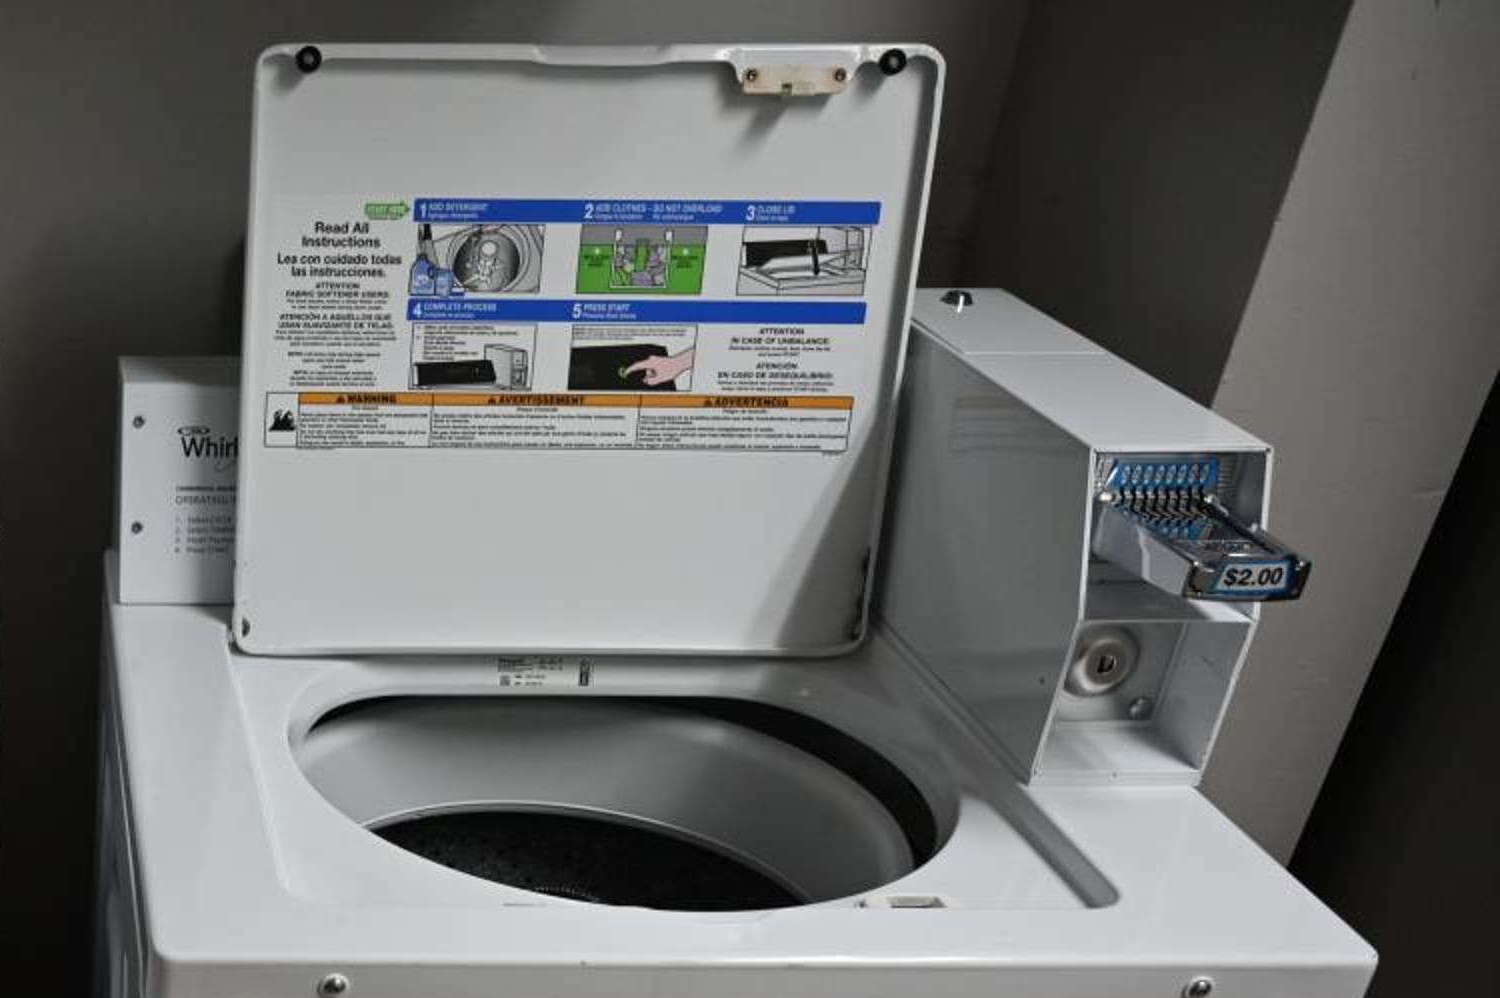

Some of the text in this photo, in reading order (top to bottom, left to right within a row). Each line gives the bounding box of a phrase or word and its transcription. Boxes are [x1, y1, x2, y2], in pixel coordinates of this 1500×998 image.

[584, 203, 594, 219] 2
[746, 204, 756, 221] 3
[315, 222, 369, 233] Read All
[302, 235, 381, 248] Instructions
[277, 252, 402, 264] Lea con cuidado todas
[292, 266, 387, 277] las instrucciones.
[413, 302, 422, 318] 4
[572, 302, 581, 319] 5
[348, 394, 397, 404] WARNING
[499, 394, 585, 406] AVERTISSEMENT
[714, 396, 789, 408] ADVERTENCIA
[181, 436, 238, 457] Whirl
[1223, 567, 1284, 586] $2.00
